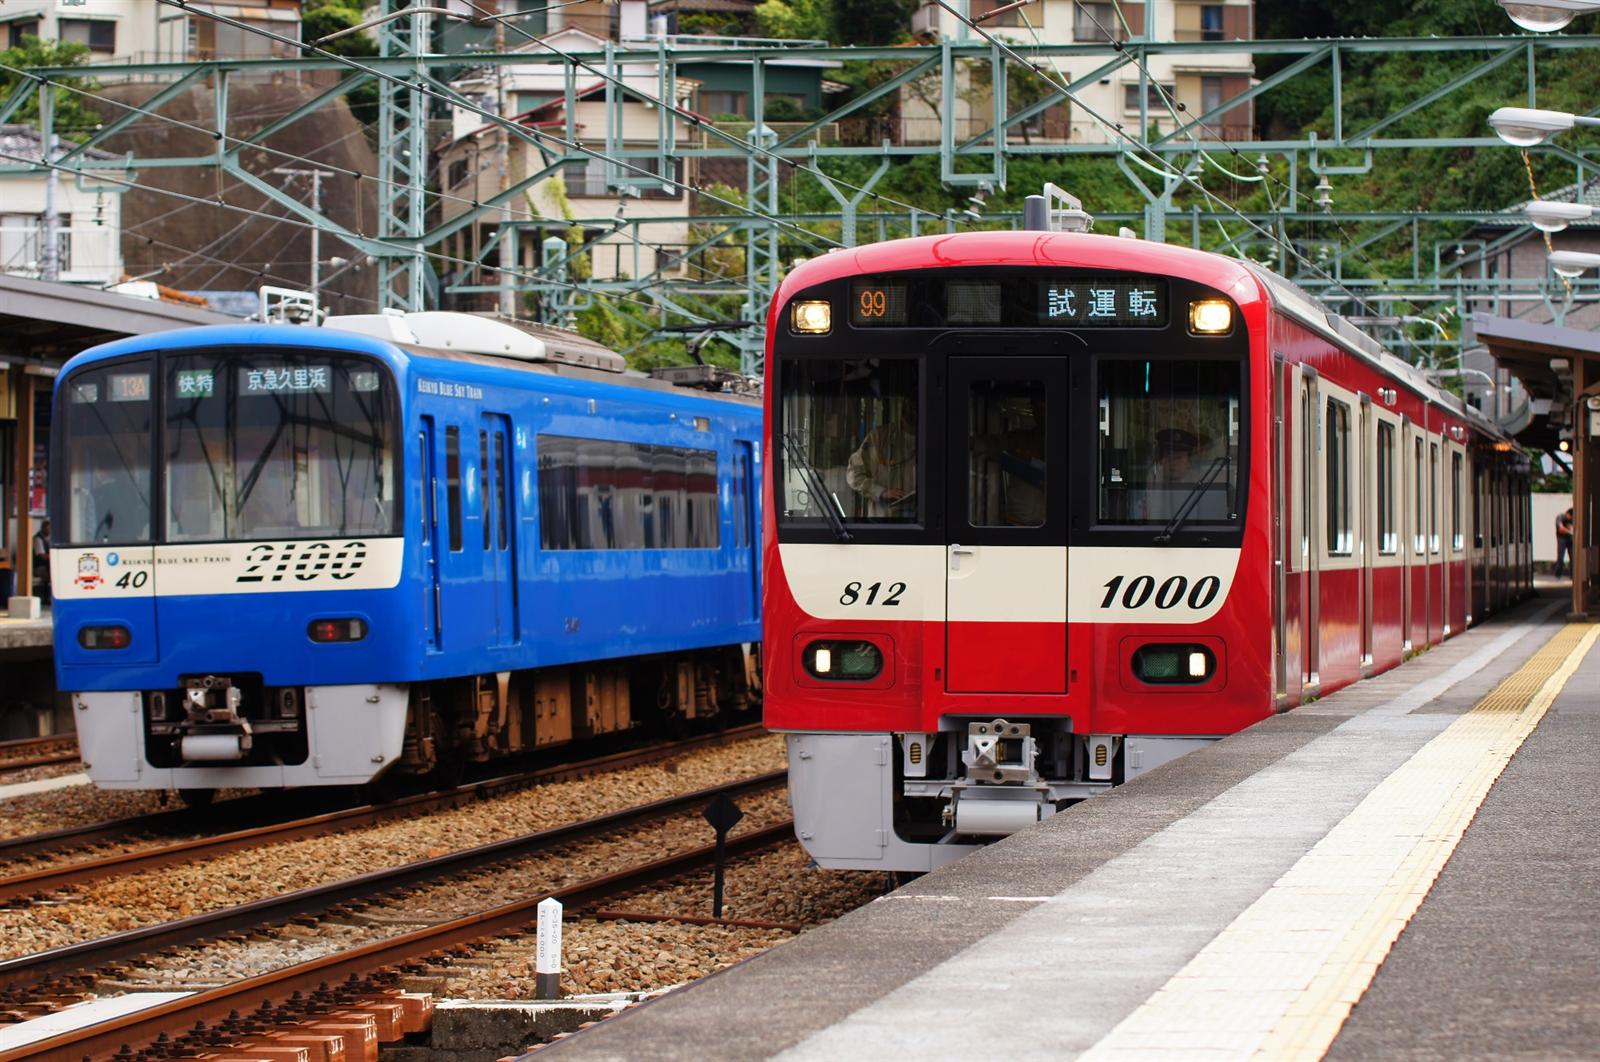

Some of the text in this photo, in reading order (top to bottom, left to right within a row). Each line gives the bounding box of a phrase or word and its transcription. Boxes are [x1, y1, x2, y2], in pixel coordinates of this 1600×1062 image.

[861, 291, 886, 317] 99
[1047, 287, 1158, 317] 試運転
[178, 374, 215, 393] 快特
[246, 367, 327, 391] 京急久里浜
[236, 542, 367, 583] 2100
[115, 570, 148, 589] 40
[1100, 575, 1221, 609] 1000
[839, 581, 907, 606] 812
